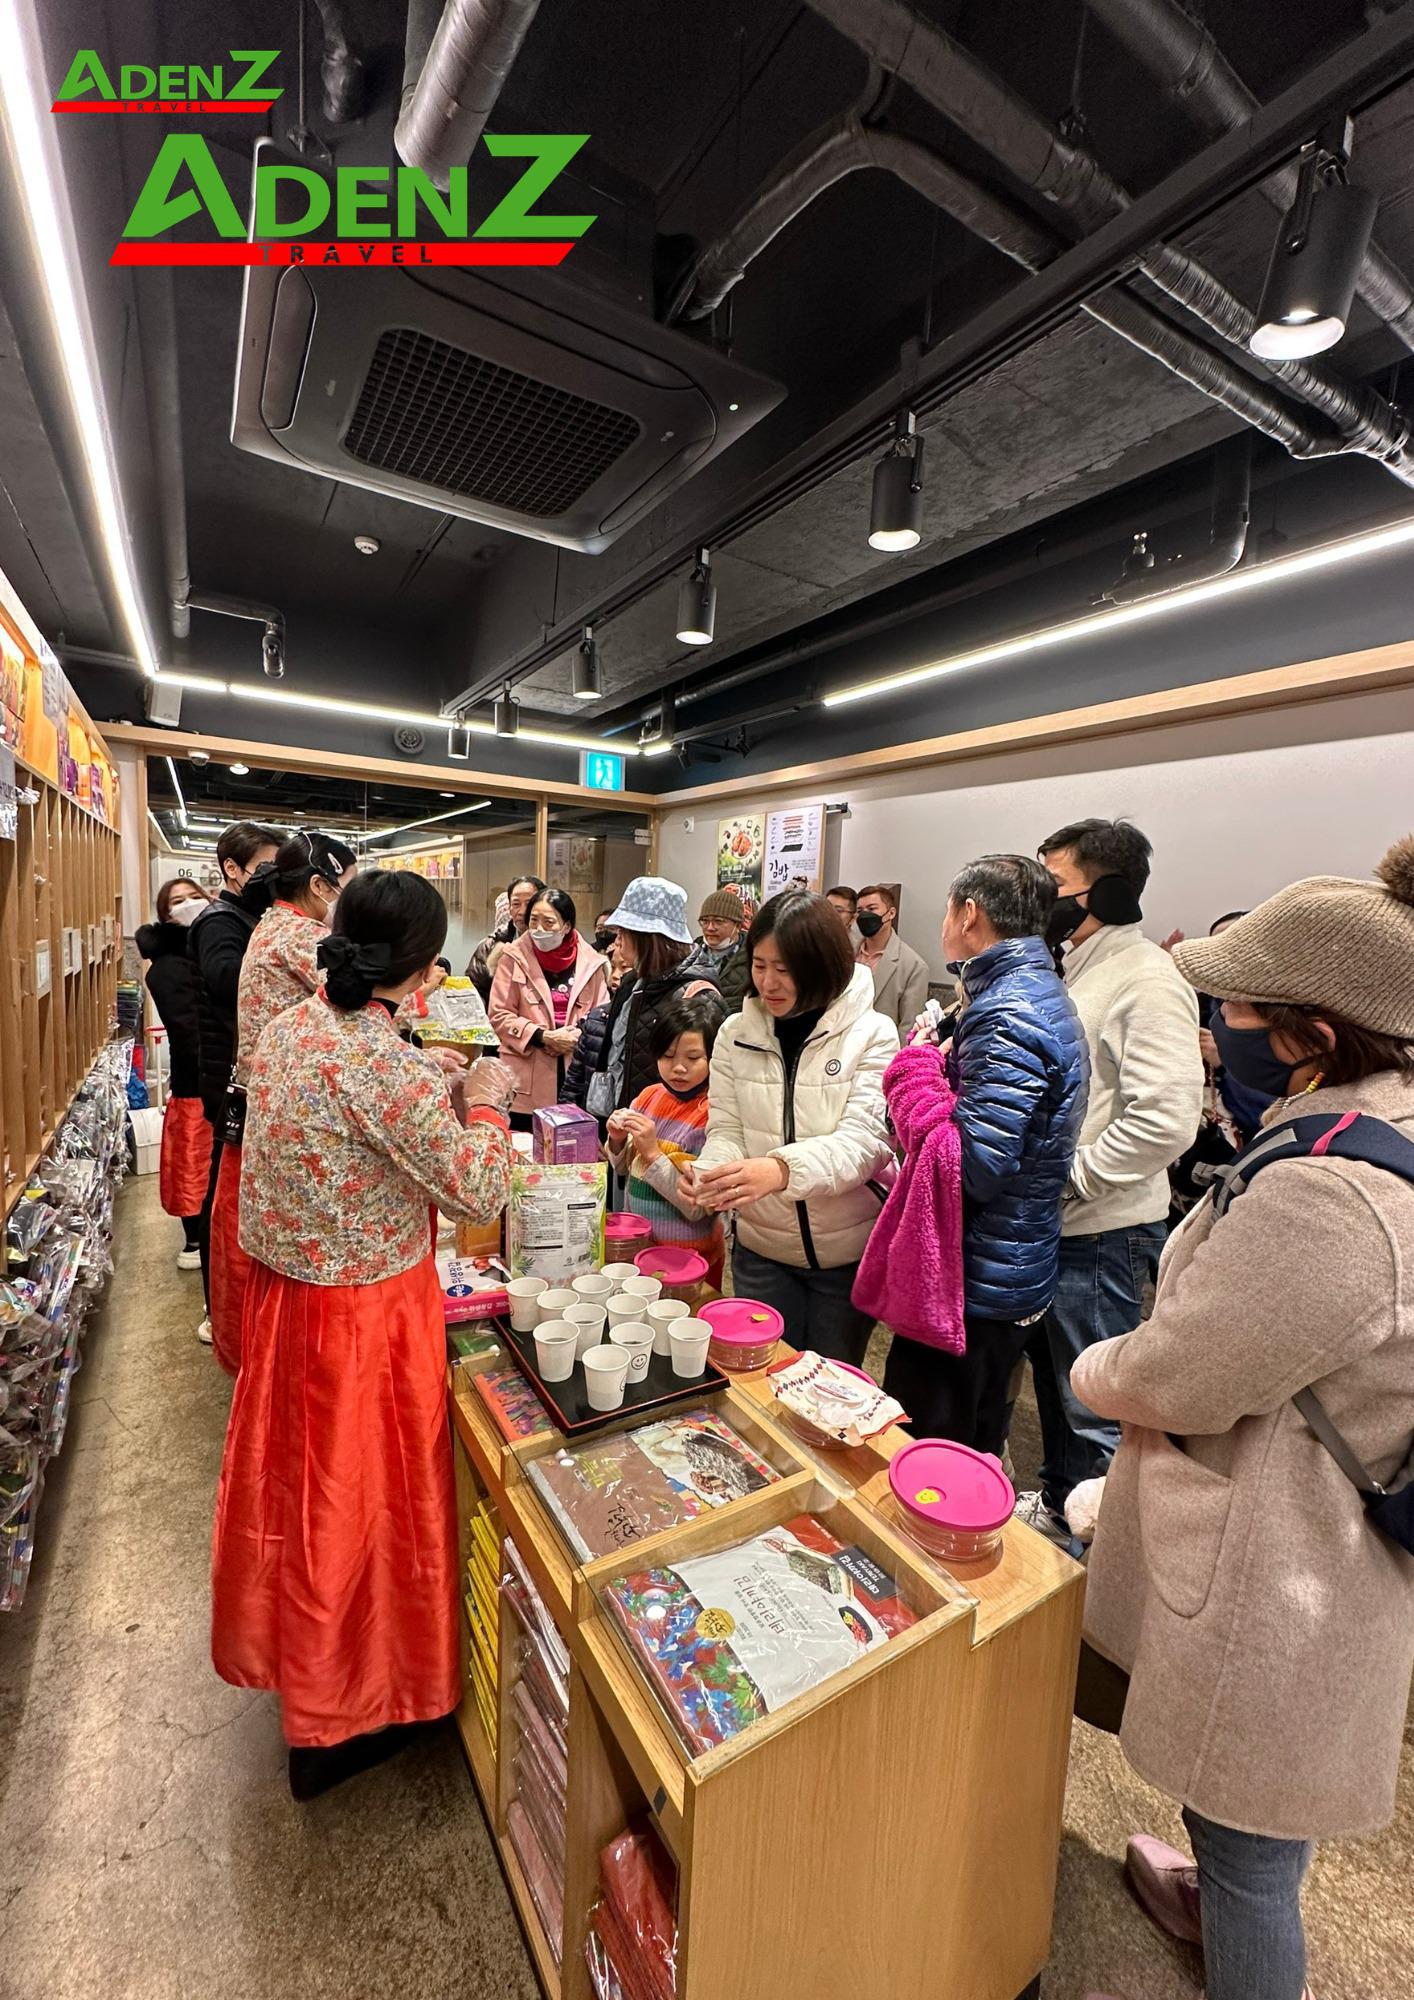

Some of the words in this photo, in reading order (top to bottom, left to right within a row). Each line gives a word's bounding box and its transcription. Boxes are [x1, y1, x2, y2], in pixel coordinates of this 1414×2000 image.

[178, 868, 193, 877] 06
[769, 859, 789, 881] 김밥
[839, 1555, 880, 1594] 데리야끼김
[733, 1575, 785, 1634] 데리야끼김
